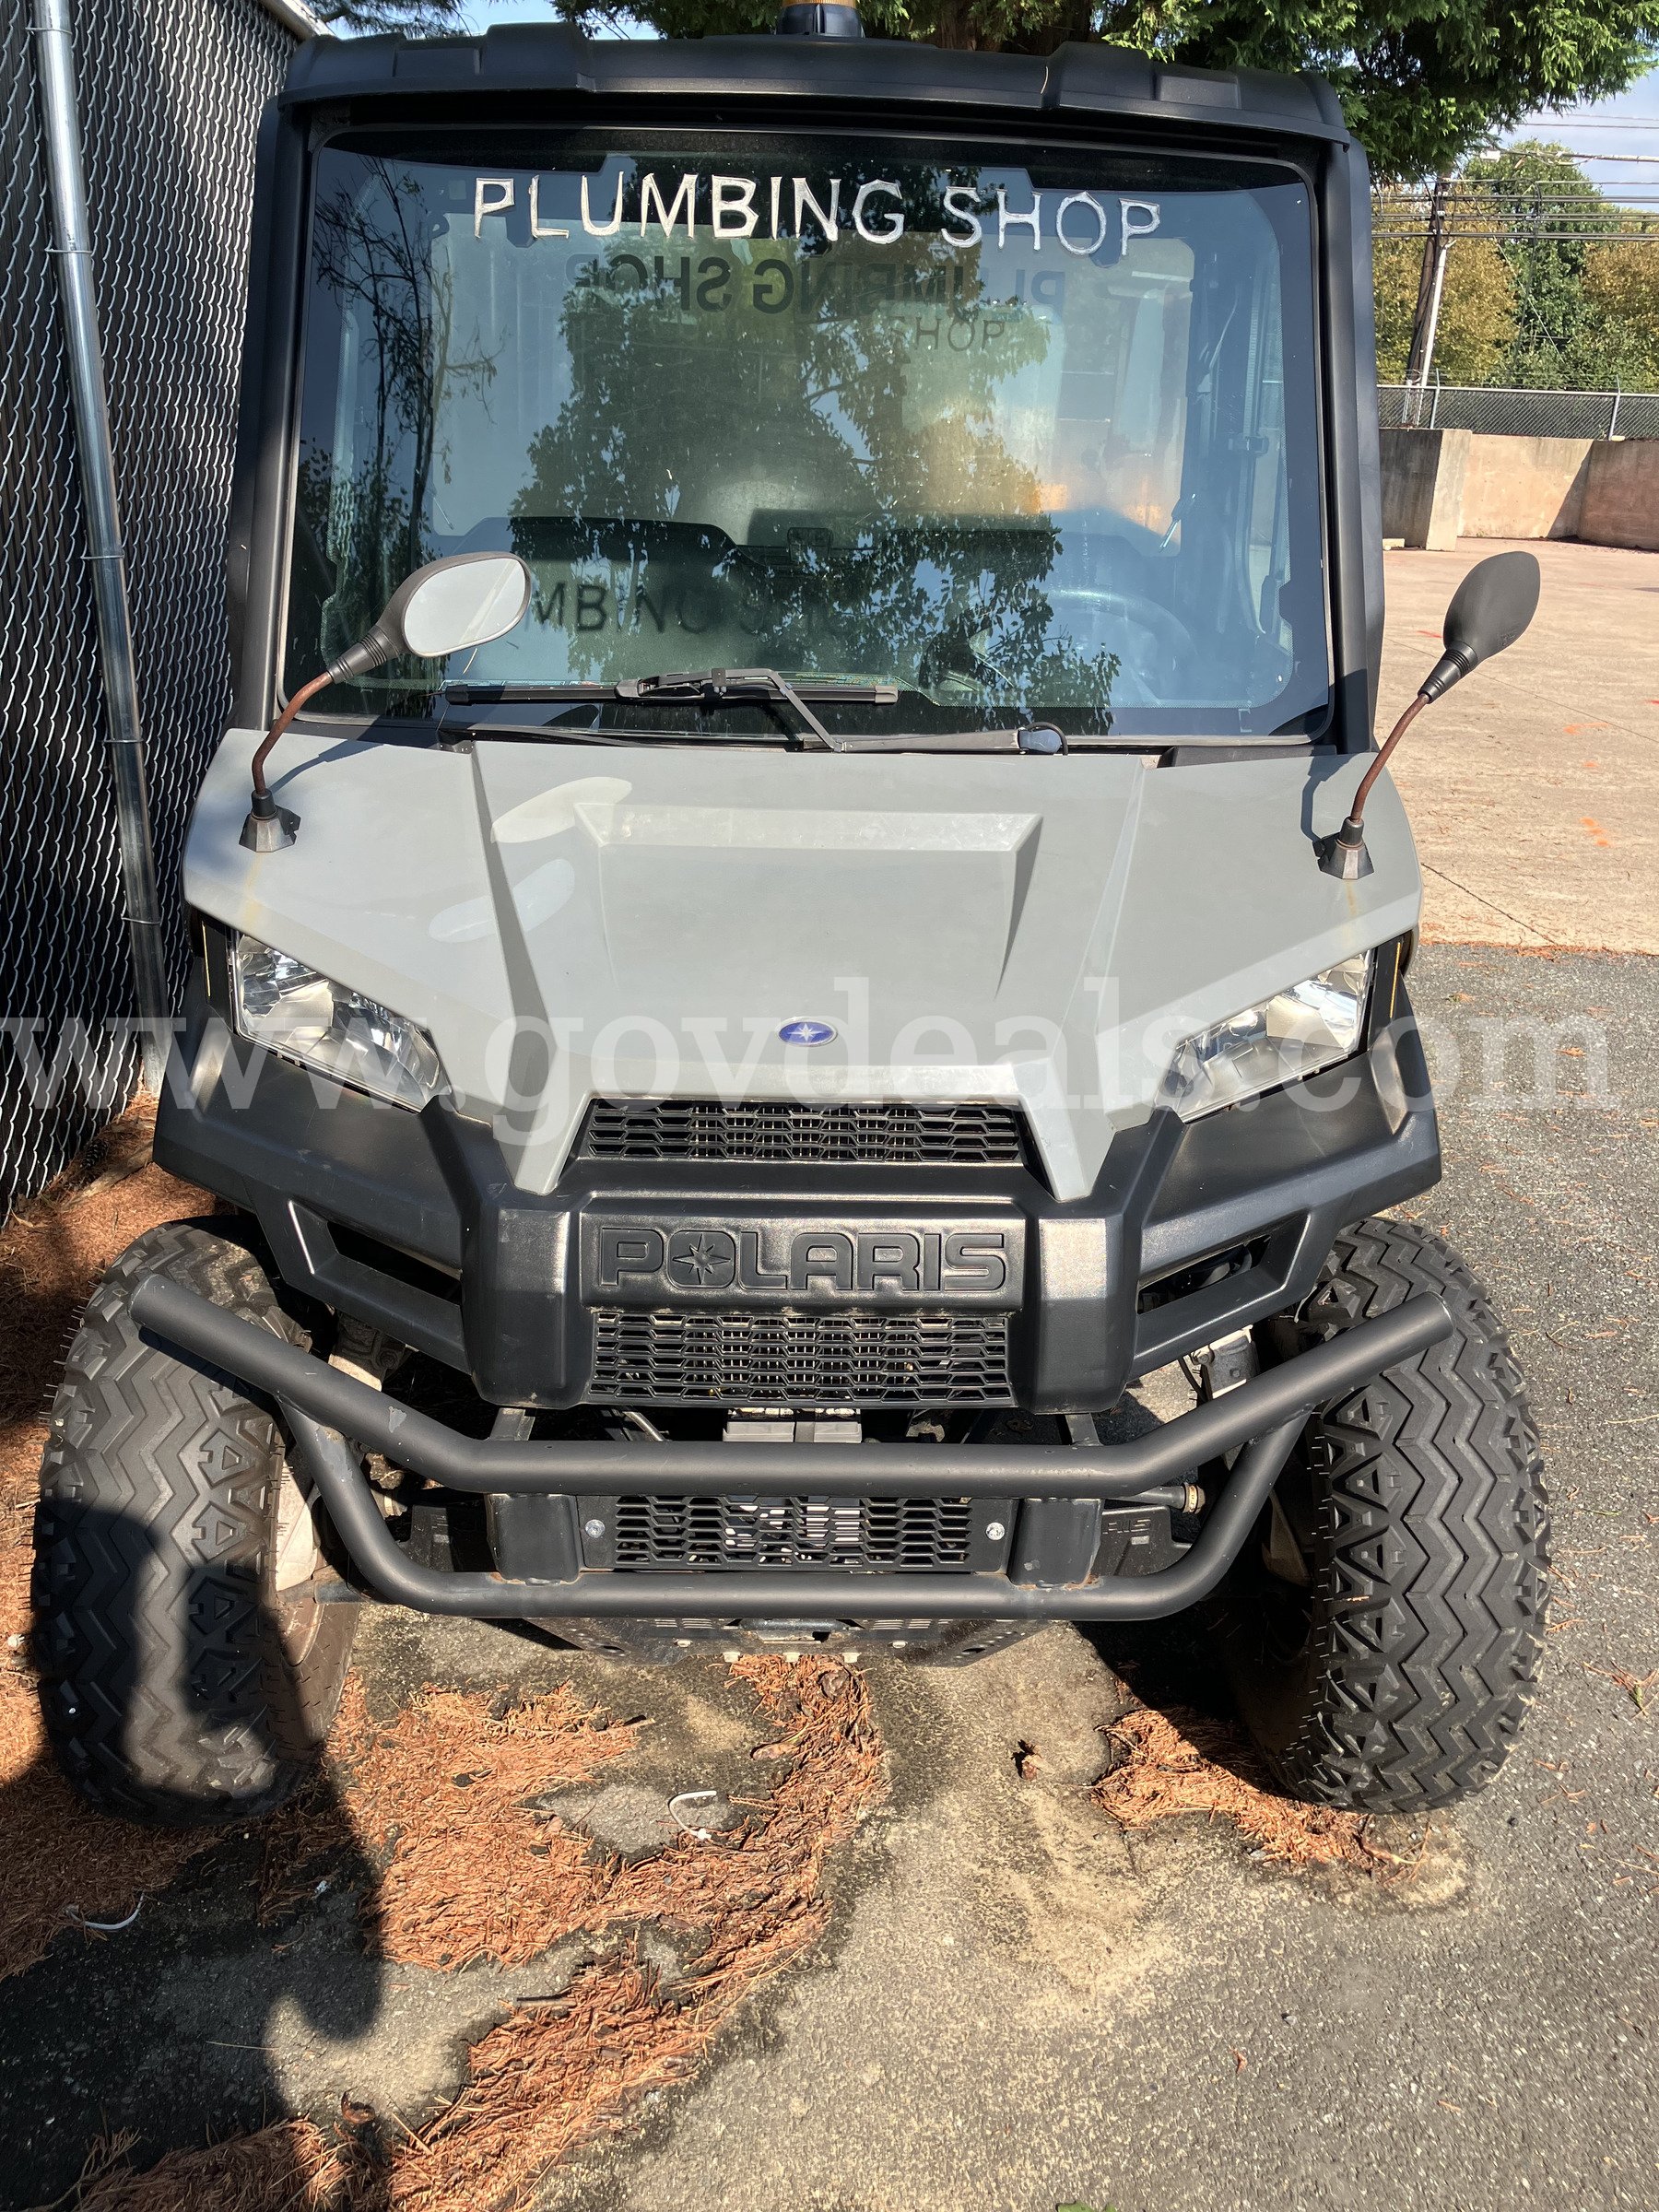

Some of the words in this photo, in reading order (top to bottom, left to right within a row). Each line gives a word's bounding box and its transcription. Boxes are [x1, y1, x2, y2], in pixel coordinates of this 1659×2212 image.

[473, 171, 905, 243] PLUMBING
[940, 186, 1161, 257] SHOP
[601, 1227, 1006, 1291] POLARIS
